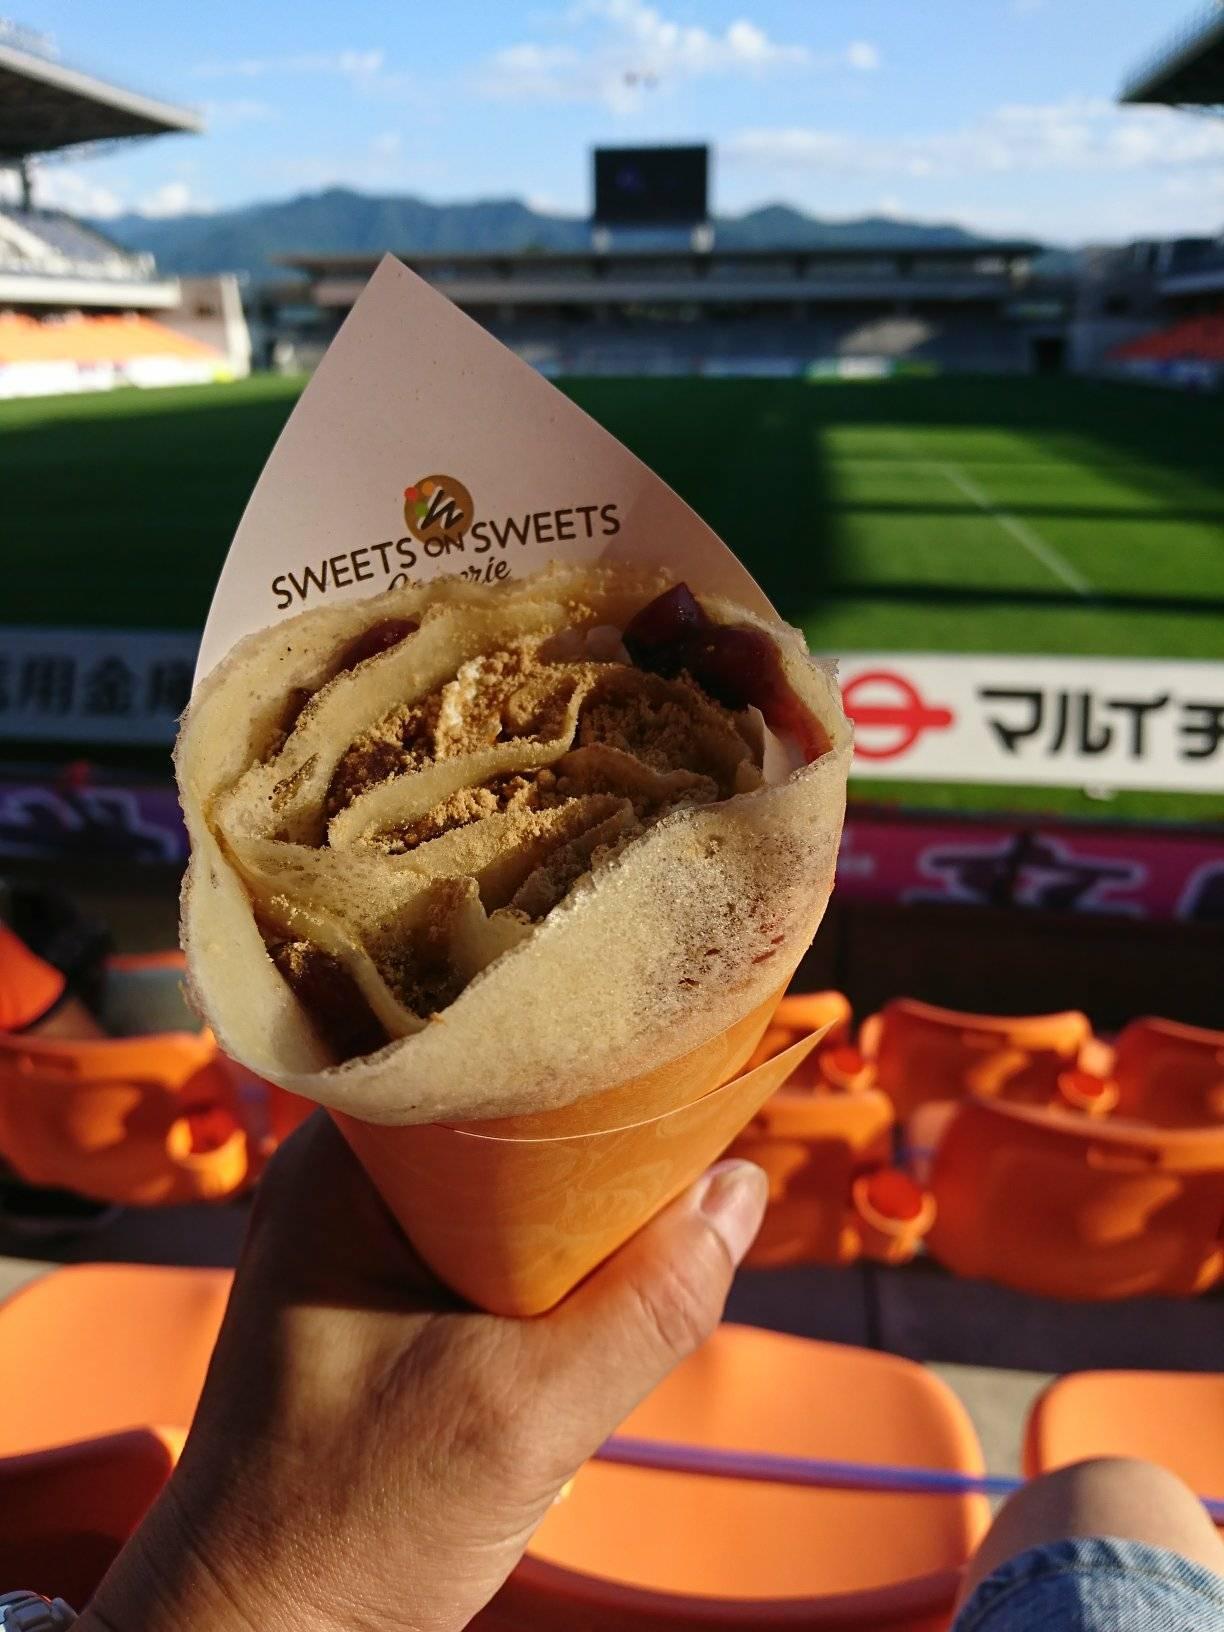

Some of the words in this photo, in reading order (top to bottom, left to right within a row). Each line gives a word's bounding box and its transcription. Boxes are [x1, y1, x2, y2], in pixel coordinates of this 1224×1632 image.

[271, 537, 417, 610] SWEETS
[423, 531, 465, 558] ON
[470, 503, 622, 554] SWEETS
